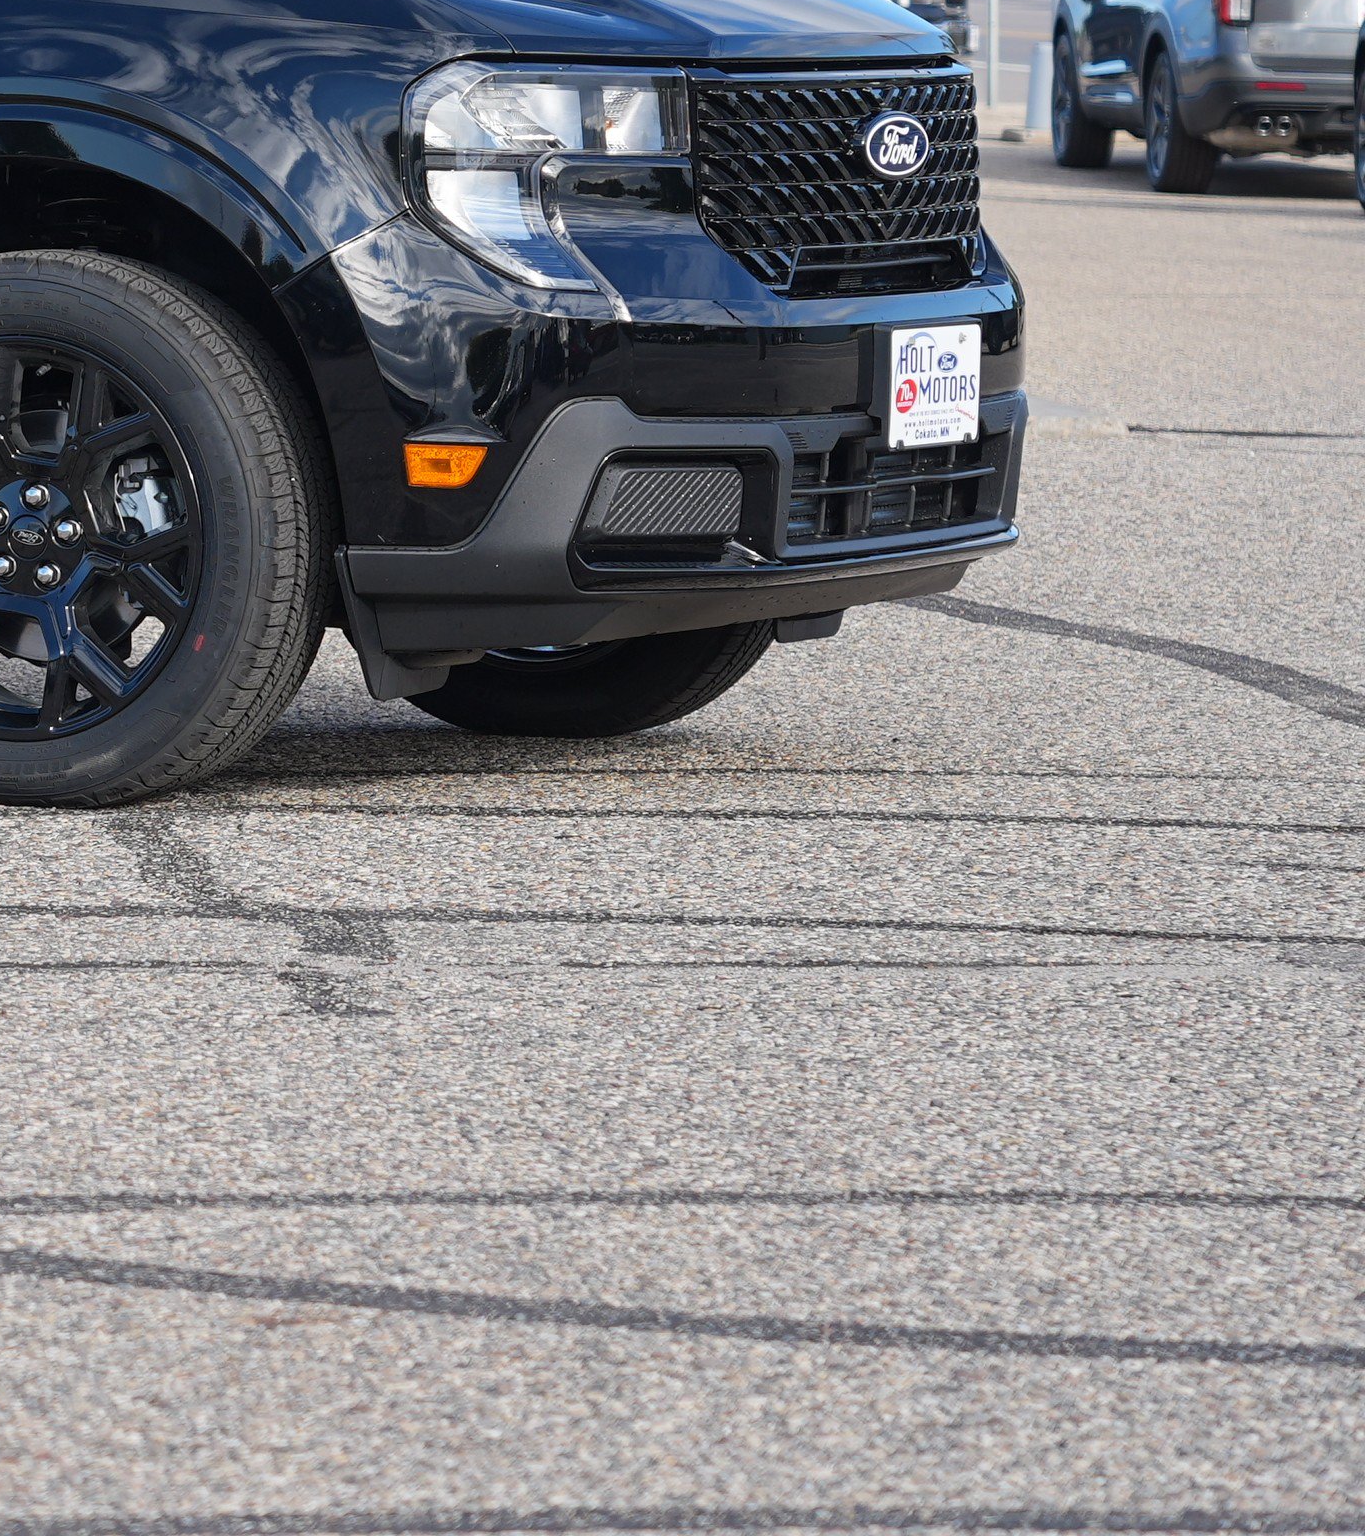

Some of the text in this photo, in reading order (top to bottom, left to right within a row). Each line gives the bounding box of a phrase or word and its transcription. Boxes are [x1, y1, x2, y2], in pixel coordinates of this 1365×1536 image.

[879, 124, 919, 165] Ford
[899, 345, 935, 375] HOLT
[919, 375, 977, 405] MOTORS
[940, 426, 950, 437] MN
